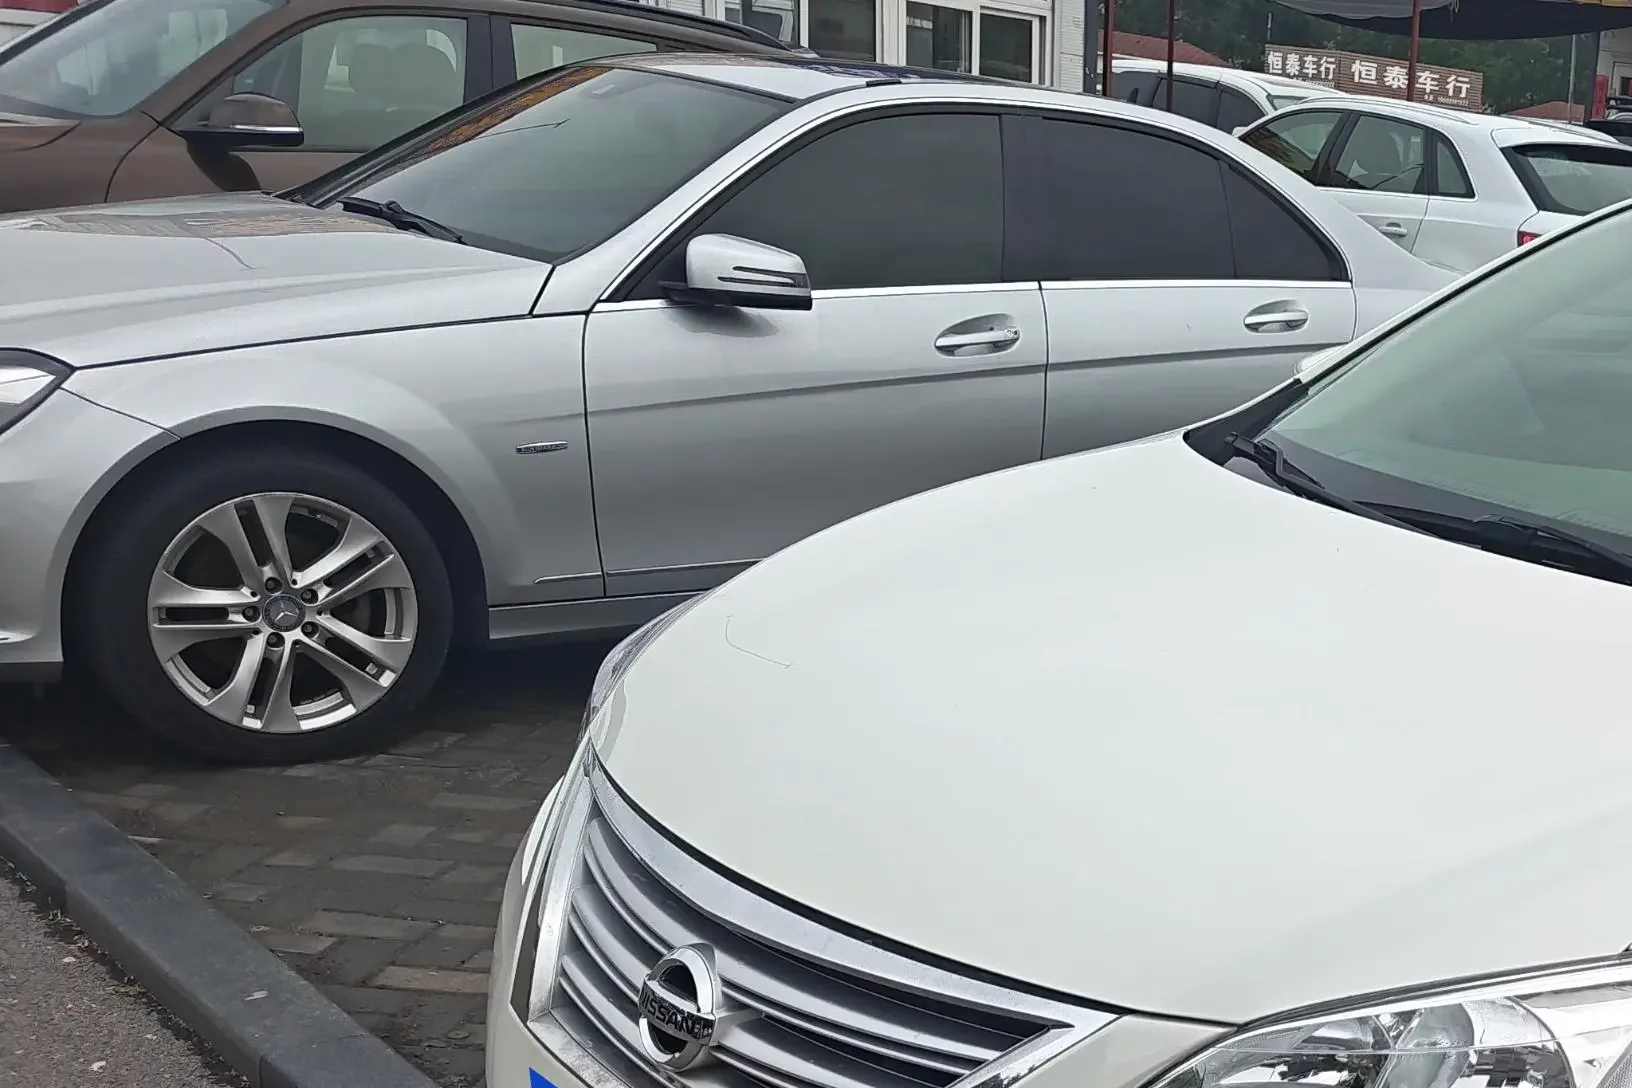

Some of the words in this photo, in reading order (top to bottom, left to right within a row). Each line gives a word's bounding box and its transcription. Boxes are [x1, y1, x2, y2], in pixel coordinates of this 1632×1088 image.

[1267, 51, 1337, 80] 恒泰车行
[1351, 60, 1471, 98] 恒泰车行
[640, 984, 696, 1036] NISSAN
